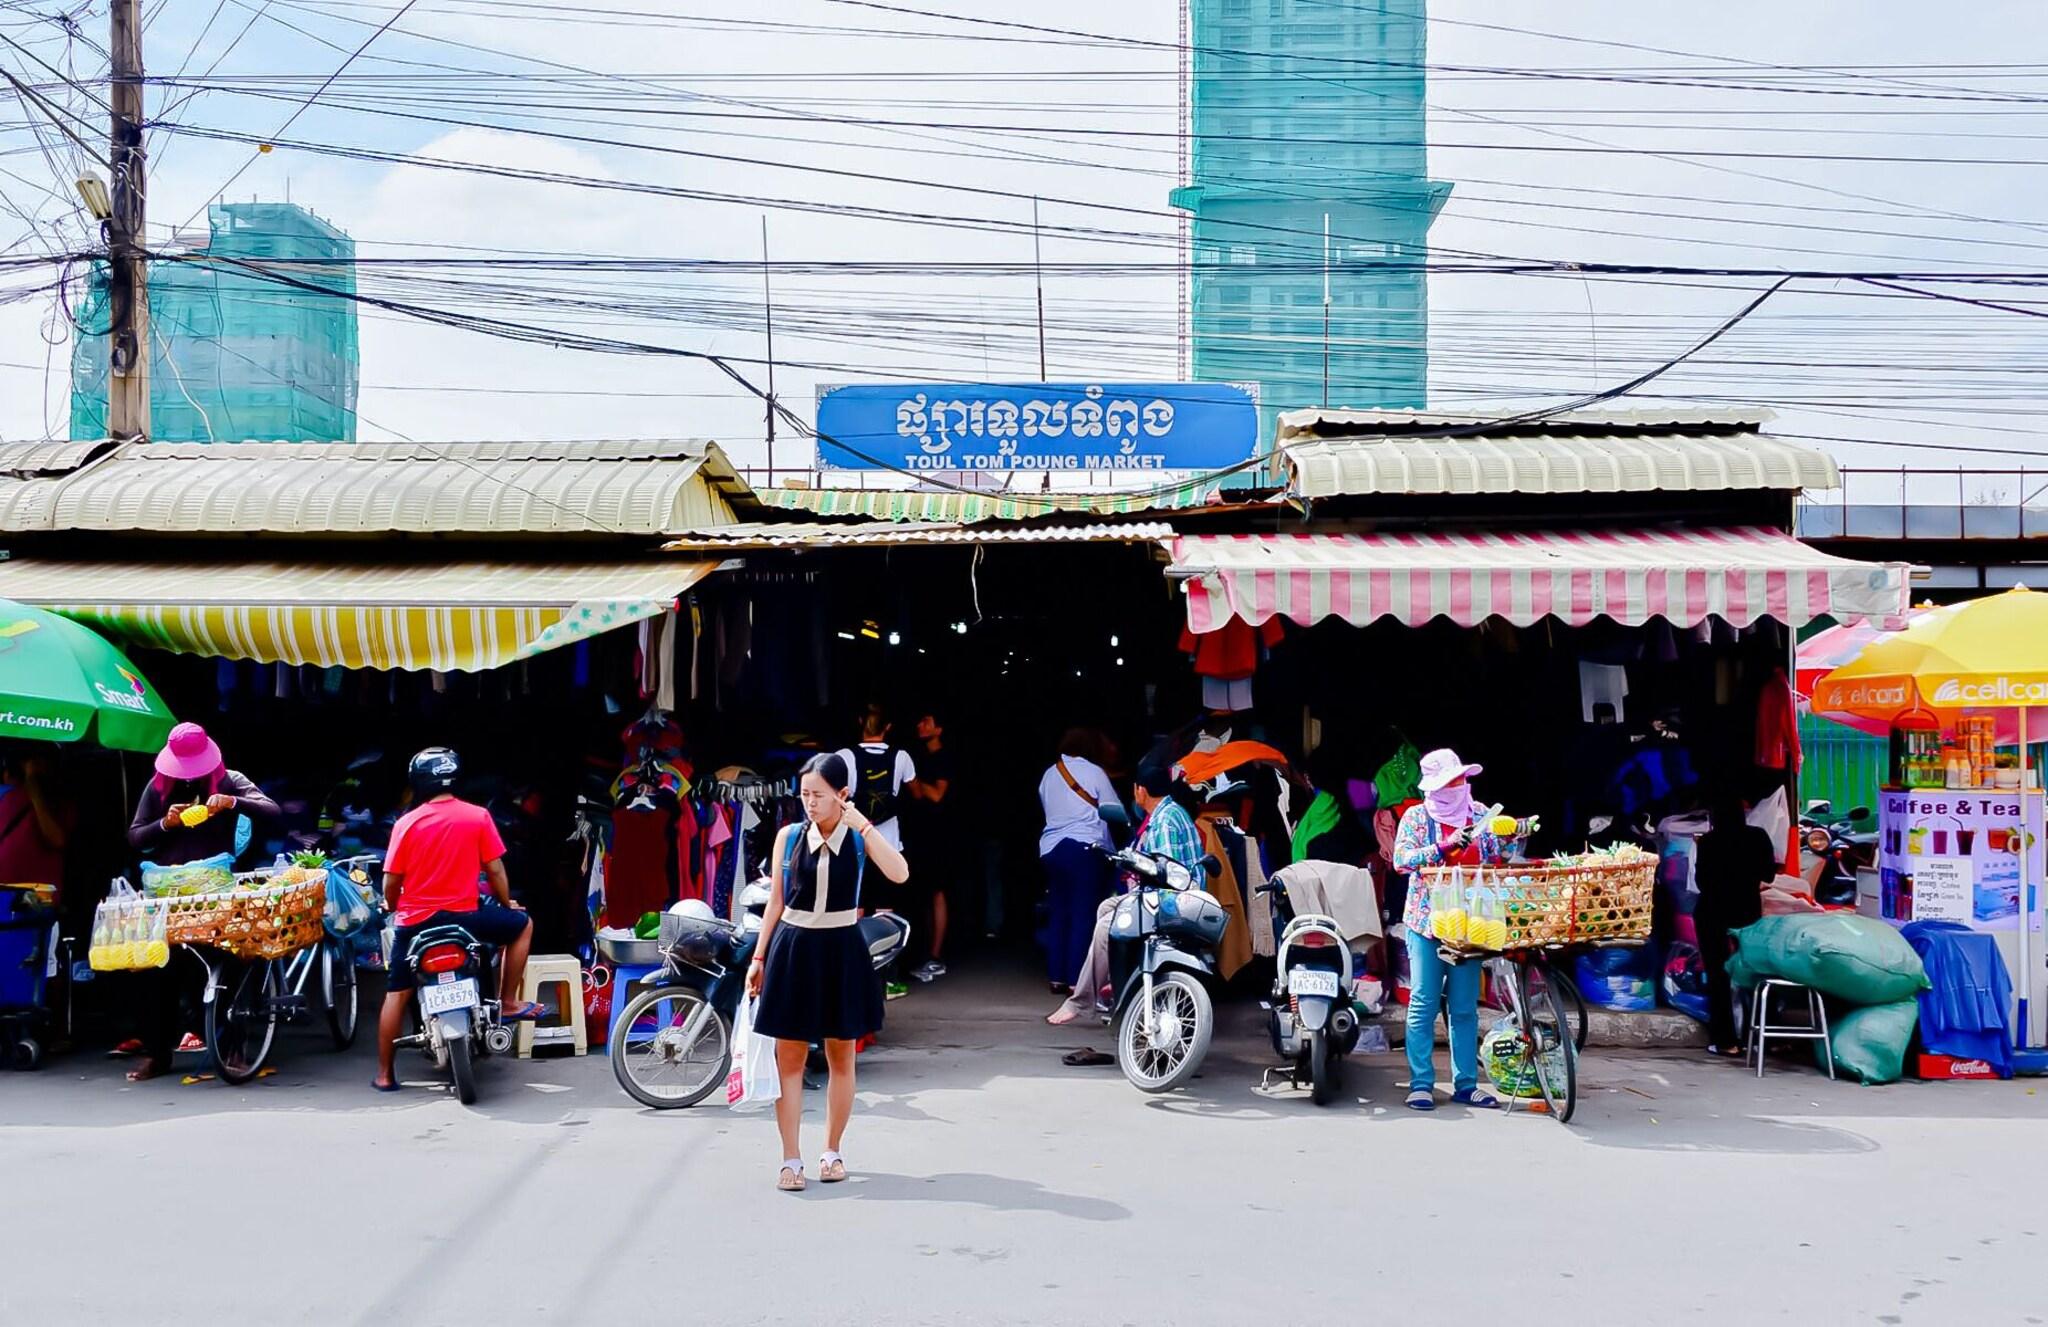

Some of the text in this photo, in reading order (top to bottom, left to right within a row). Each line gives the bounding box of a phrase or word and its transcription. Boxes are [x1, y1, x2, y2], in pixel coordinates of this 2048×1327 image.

[905, 455, 1165, 469] TOUL TOM POUNG MARKET
[95, 682, 152, 712] Smart
[1955, 800, 1972, 815] &
[1979, 800, 2021, 816] Tea
